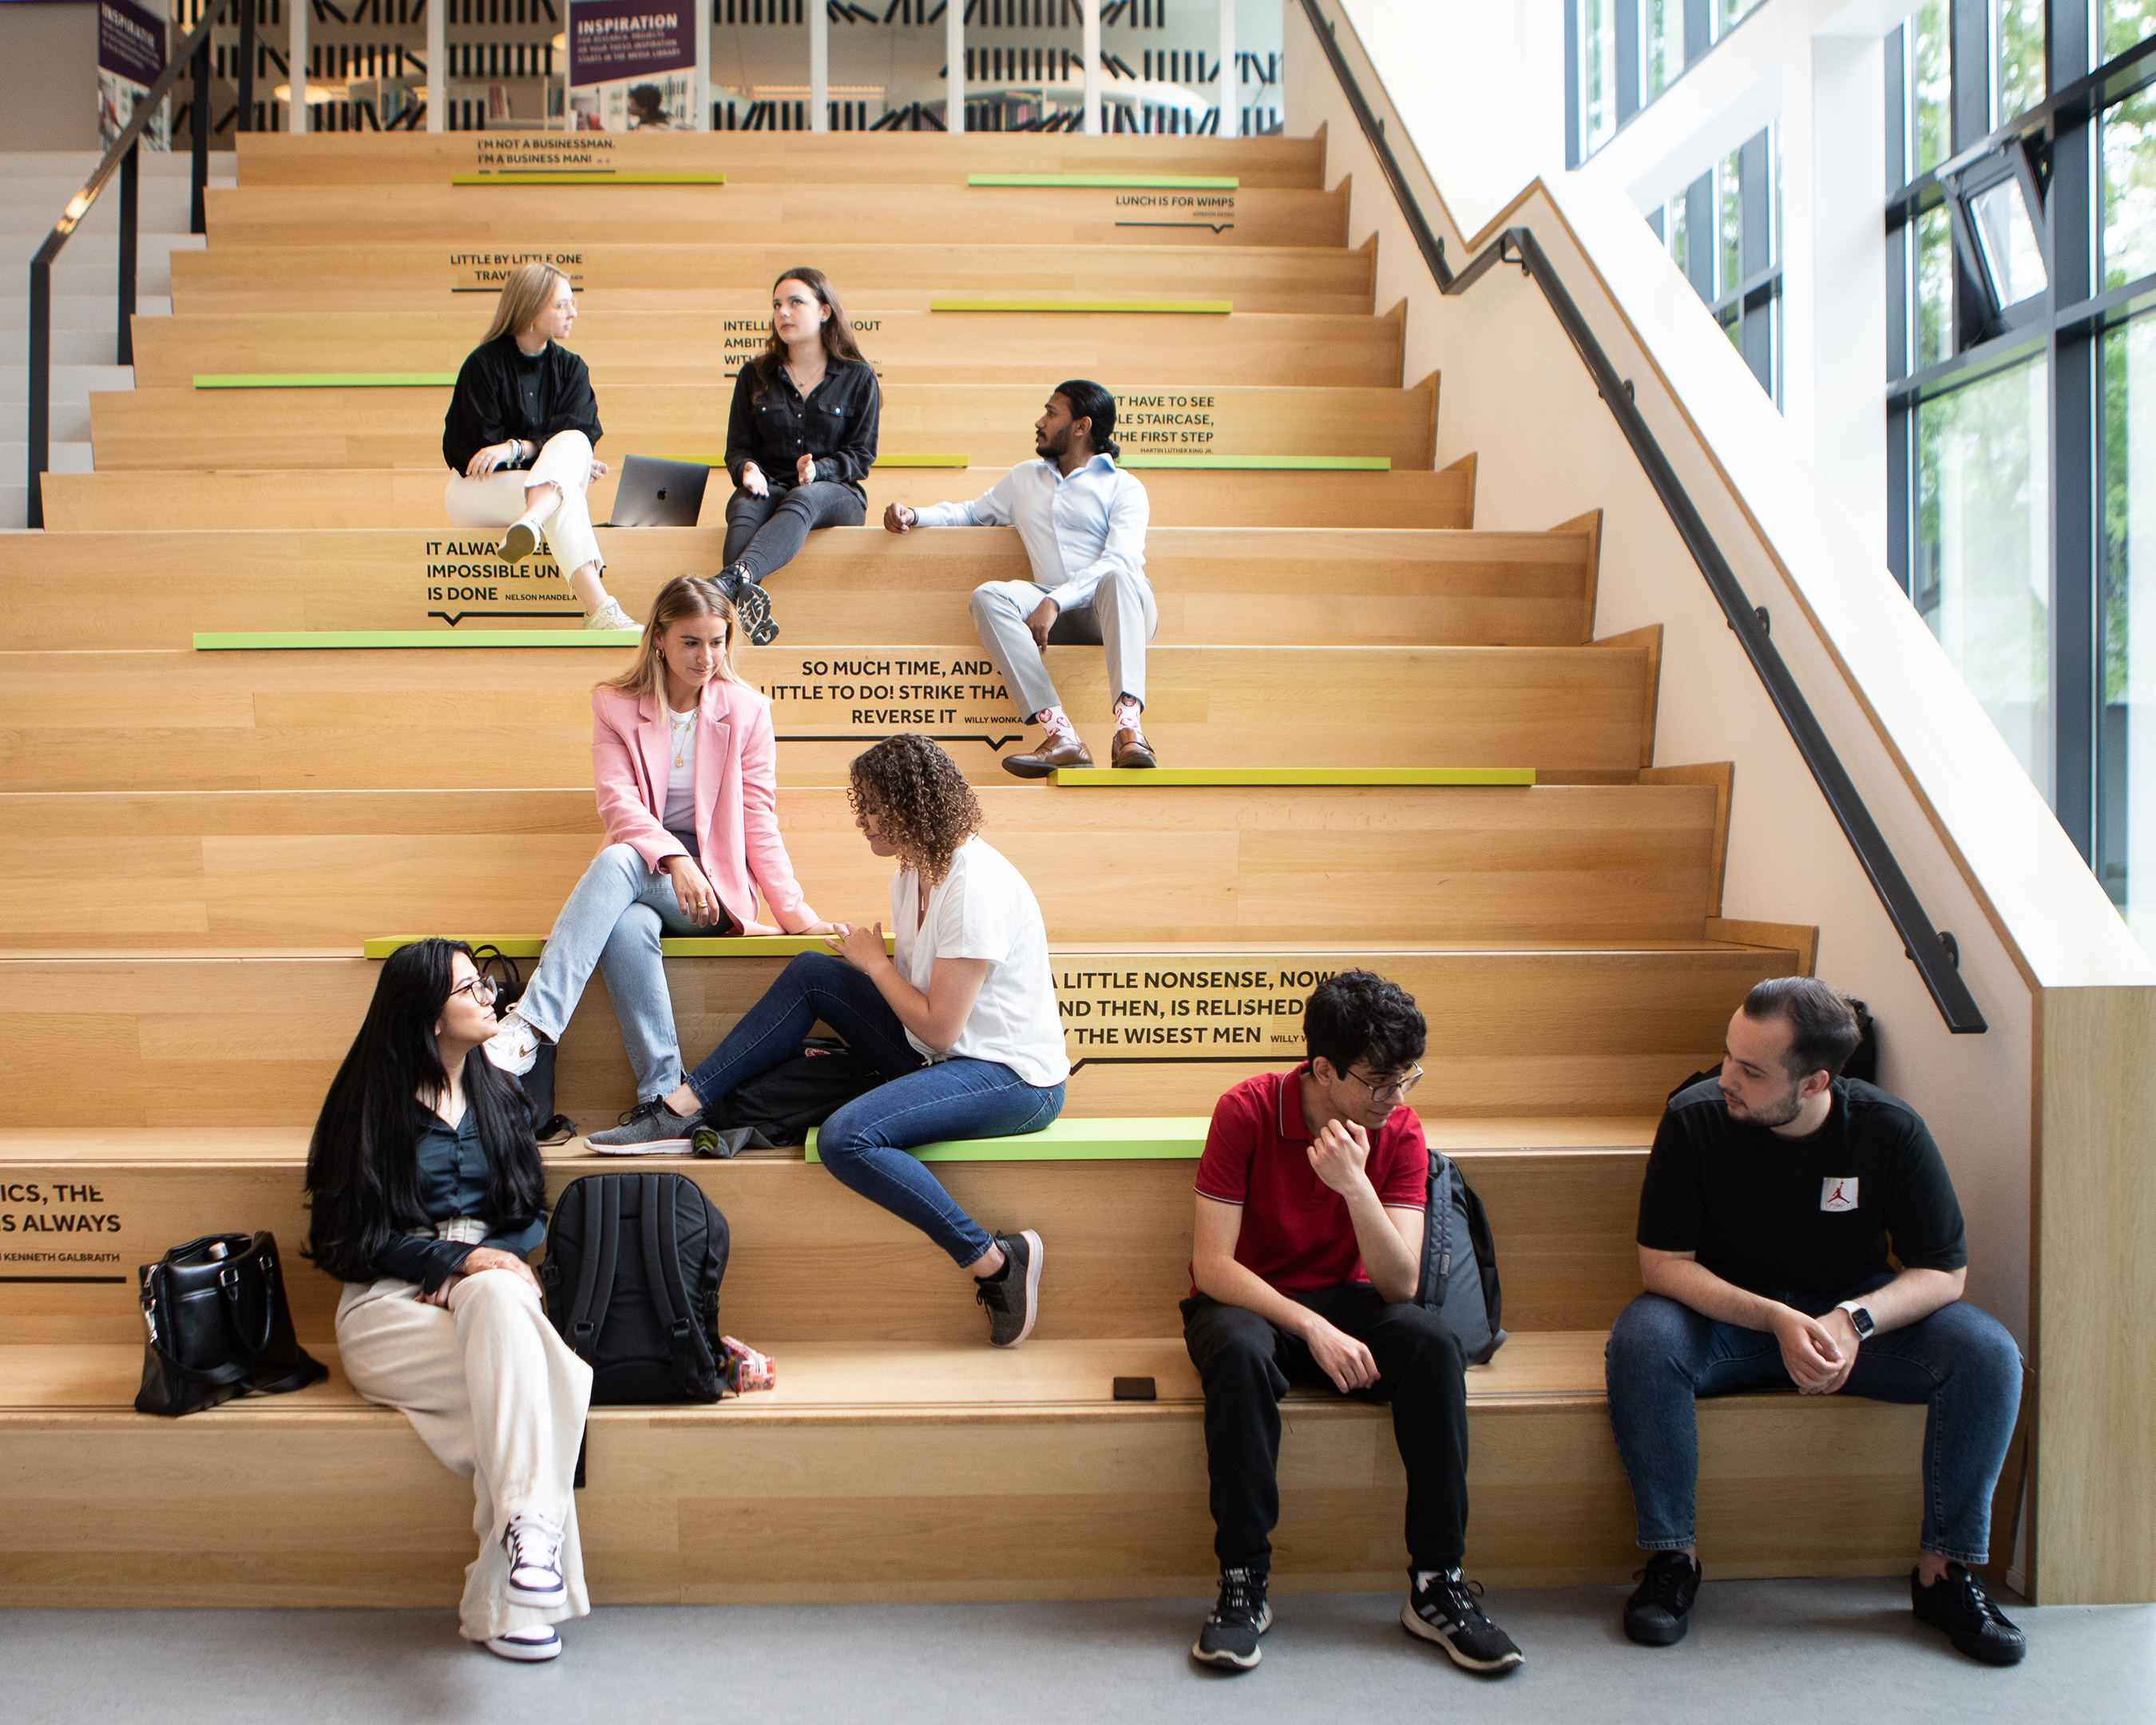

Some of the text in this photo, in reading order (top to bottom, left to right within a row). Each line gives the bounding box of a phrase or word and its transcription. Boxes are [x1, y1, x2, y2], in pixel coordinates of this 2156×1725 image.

[578, 13, 677, 34] INSPIRATION
[478, 139, 616, 149] I'M NOT A BUSINESSMAN.
[478, 154, 493, 163] I'M
[497, 154, 504, 163] A
[506, 153, 560, 163] BUSINESS
[563, 153, 592, 163] MAN!
[1116, 196, 1235, 207] LUNCH IS FOR WIMPS
[450, 254, 491, 264] LITTLE
[494, 254, 509, 264] BY
[556, 254, 582, 264] ONE
[724, 321, 771, 331] INTELLI
[724, 339, 767, 347] AMBIT
[1129, 396, 1164, 406] HAVE
[1168, 396, 1187, 406] TO
[1191, 396, 1215, 406] SEE
[1137, 414, 1214, 426] STAIRCASE,
[1113, 431, 1214, 442] THE FIRST STEP
[426, 542, 500, 555] IT ALWA
[427, 565, 530, 578] IMPOSSIBLE
[428, 587, 497, 601] IS DONE
[802, 661, 993, 678] SO MUCH TIME, AND
[828, 685, 854, 700] TO
[860, 685, 894, 700] DO!
[899, 685, 965, 700] STRIKE
[969, 685, 1009, 699] THA
[852, 709, 957, 724] REVERSE IT
[1064, 973, 1138, 989] LITTLE
[1144, 971, 1274, 991] NONSENSE,
[1059, 999, 1304, 1019] ND THEN, IS RELISHED
[1074, 1028, 1119, 1044] THE
[1124, 1027, 1207, 1044] WISEST
[1213, 1027, 1261, 1043] MEN
[53, 1184, 104, 1202] THE
[22, 1214, 121, 1232] ALWAYS
[58, 1253, 120, 1262] GALBRAITH
